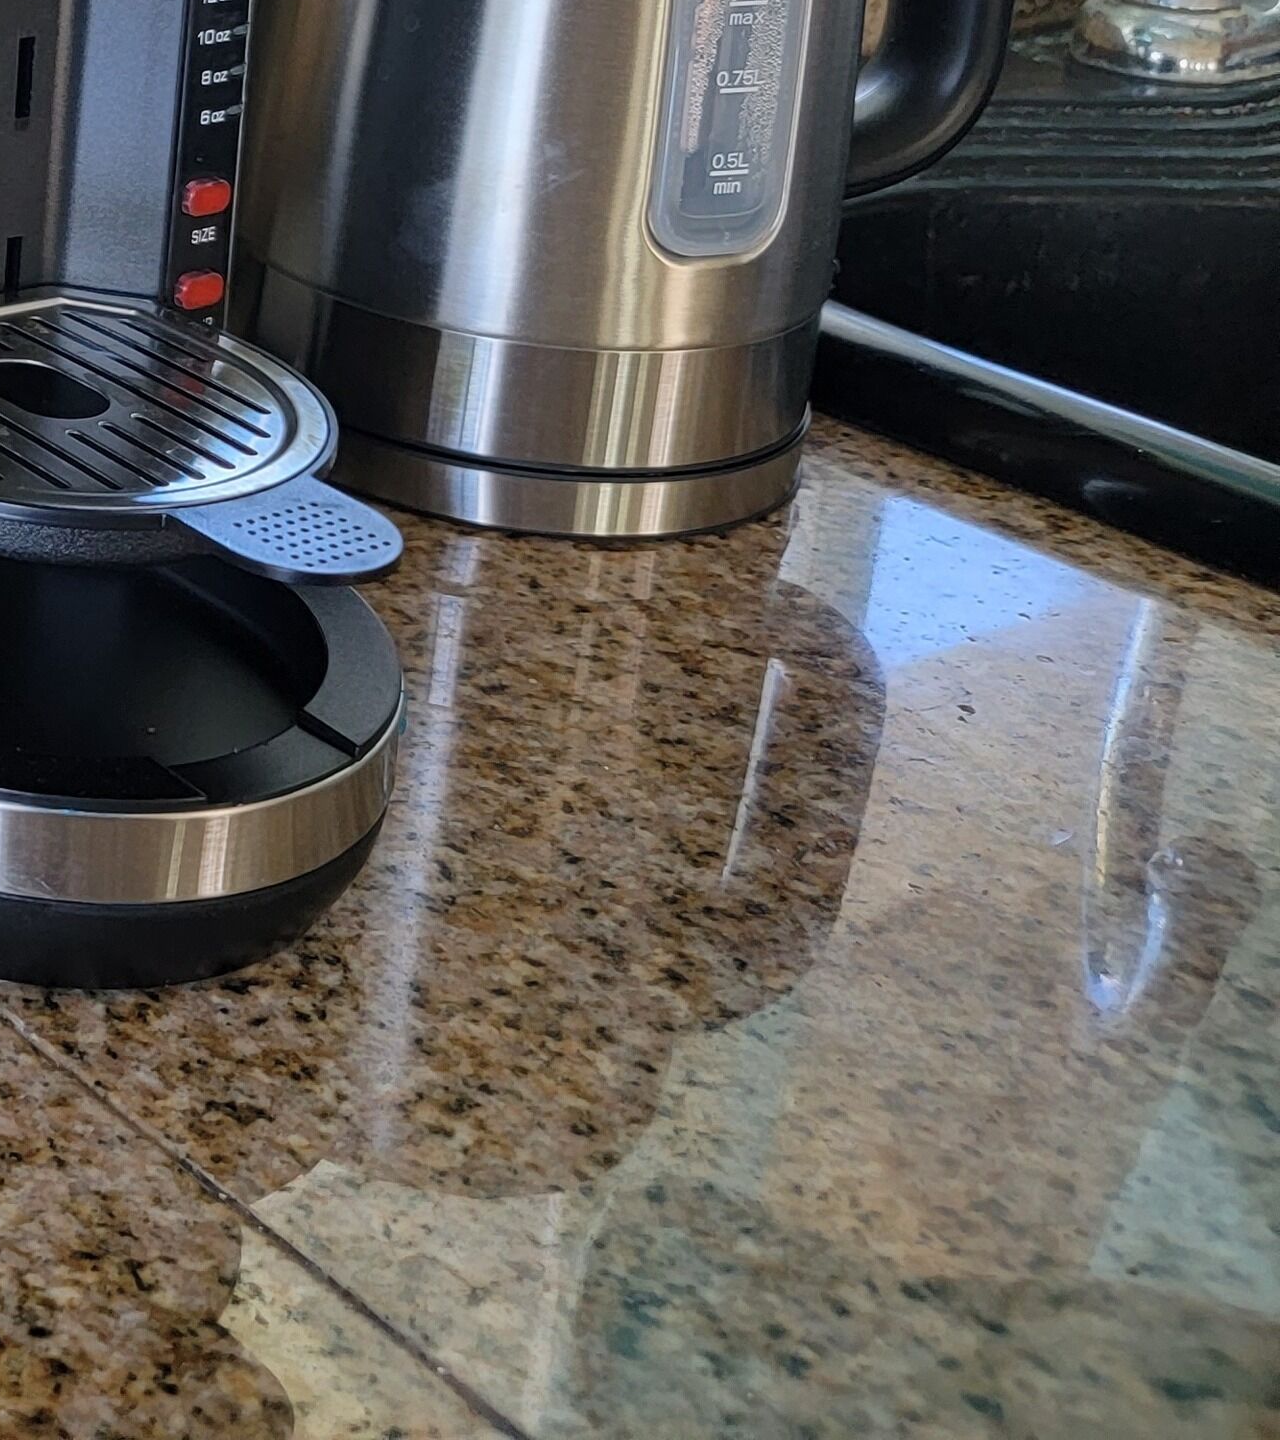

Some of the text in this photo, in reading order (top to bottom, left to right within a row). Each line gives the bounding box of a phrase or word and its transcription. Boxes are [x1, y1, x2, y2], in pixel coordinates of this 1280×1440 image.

[729, 11, 765, 26] max
[716, 70, 763, 87] 0.75L
[711, 152, 749, 169] 0.5L
[713, 178, 742, 195] min
[190, 226, 216, 244] SIZE
